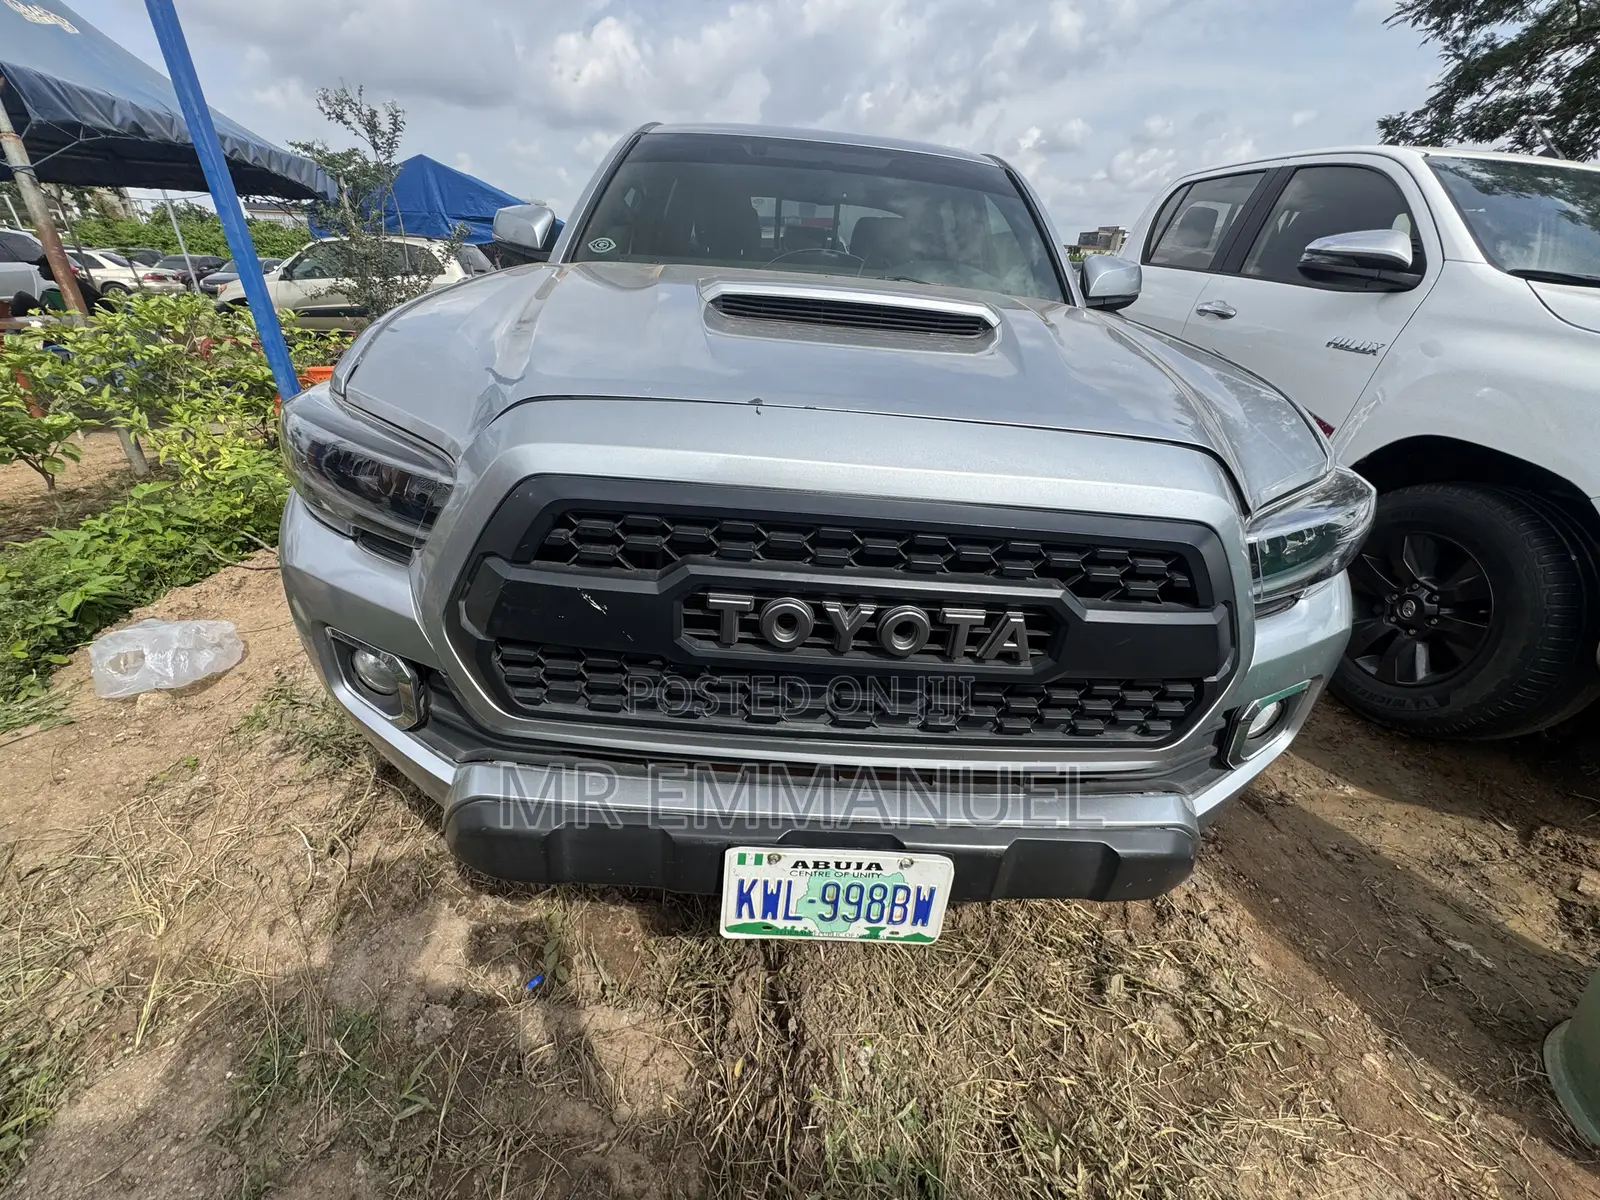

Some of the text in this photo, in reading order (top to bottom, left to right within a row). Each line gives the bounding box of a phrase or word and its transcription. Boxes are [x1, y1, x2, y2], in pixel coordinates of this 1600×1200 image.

[1325, 336, 1386, 356] HILUX
[707, 593, 1031, 661] TOYOTA
[789, 869, 831, 878] CENTRE
[790, 860, 884, 872] ABUJA
[735, 878, 937, 928] KWL-998BW
